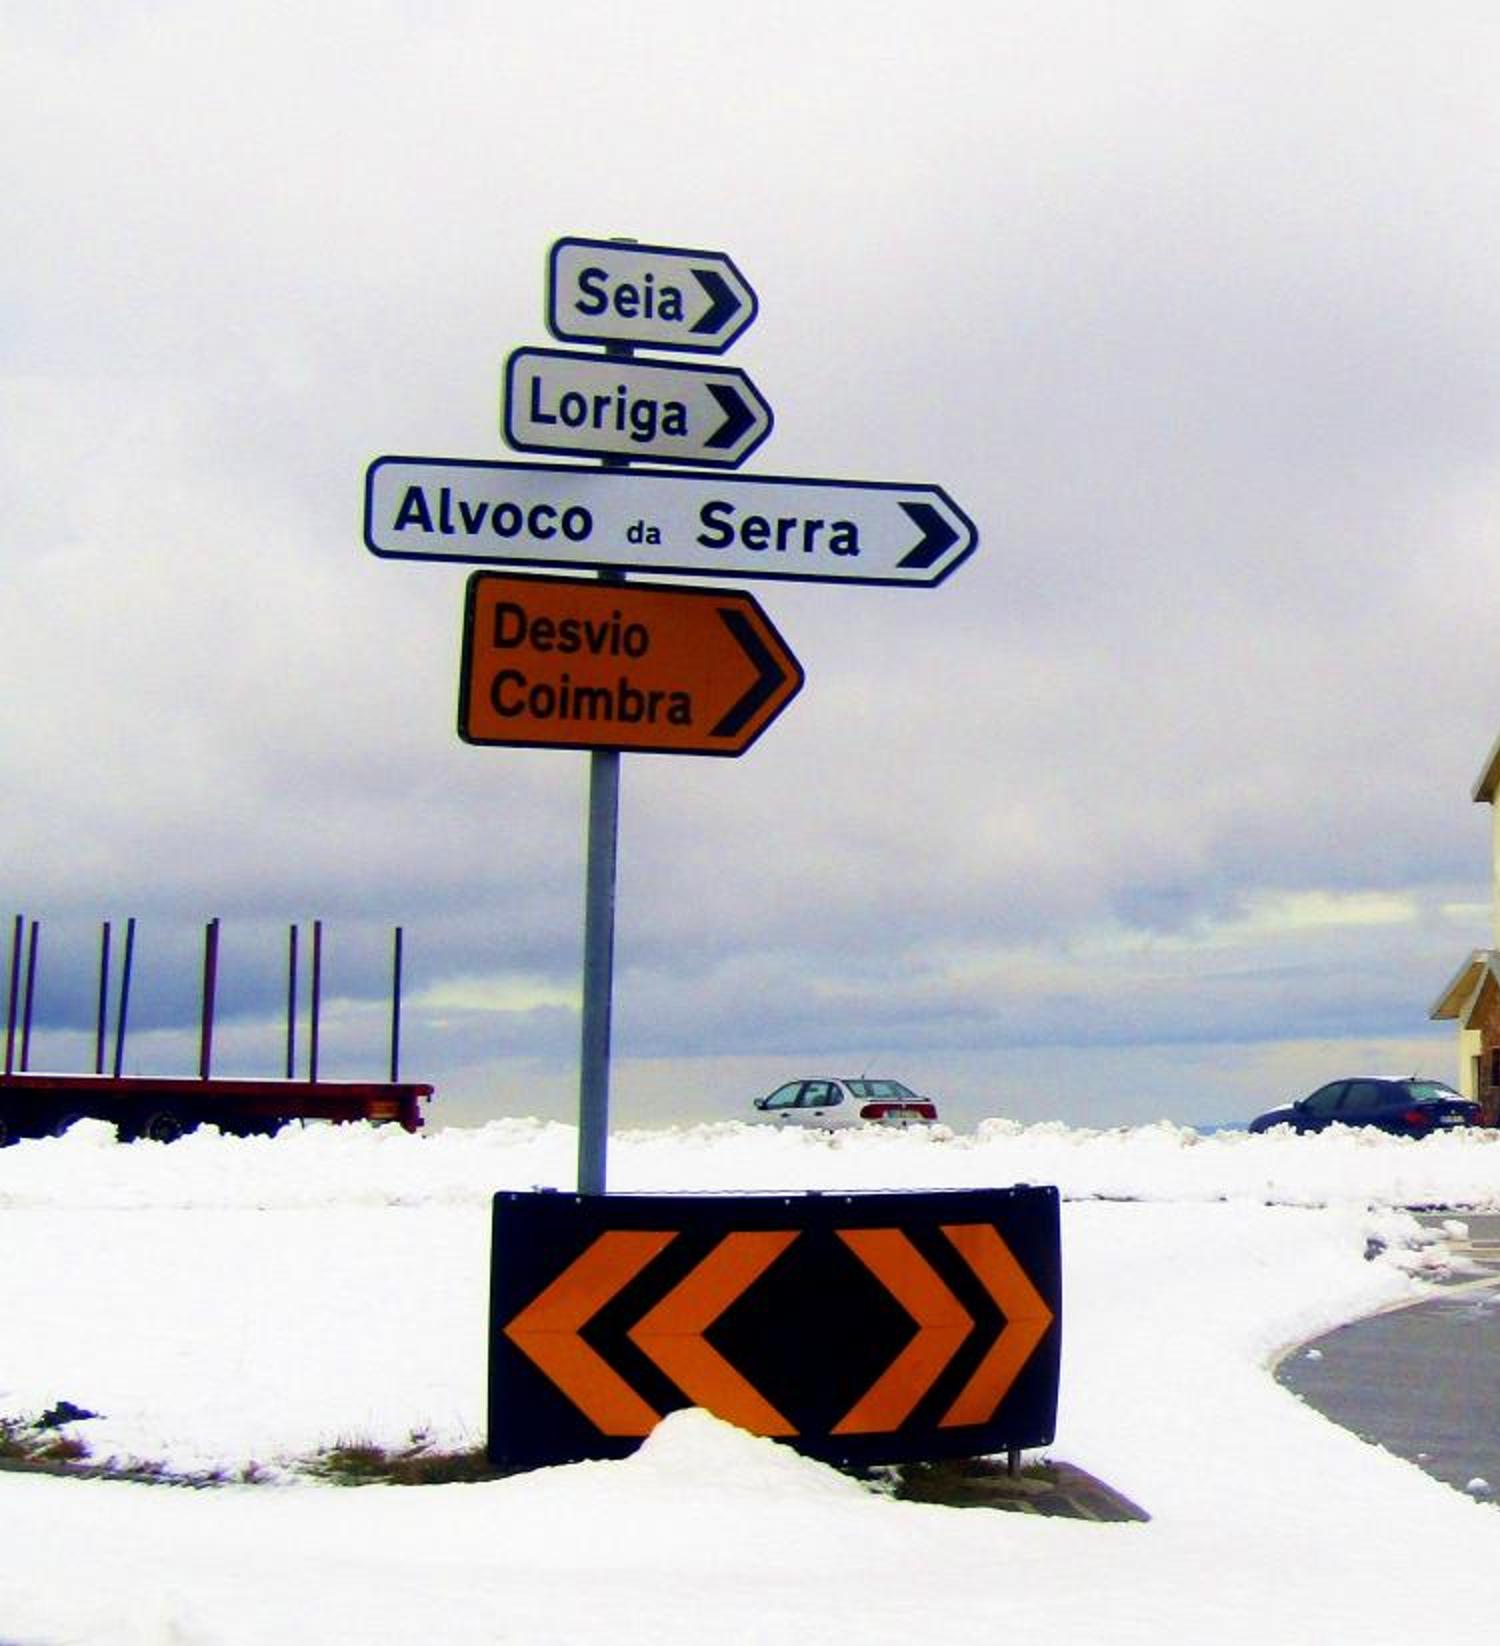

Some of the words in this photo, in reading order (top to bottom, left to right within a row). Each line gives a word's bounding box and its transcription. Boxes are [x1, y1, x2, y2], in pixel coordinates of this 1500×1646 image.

[573, 266, 684, 322] Seia
[529, 376, 688, 443] Loriga
[393, 485, 594, 542] Alvoco
[626, 520, 662, 546] da
[696, 500, 861, 557] Serra
[493, 602, 650, 660] Desvio
[490, 668, 693, 726] Coimbra
